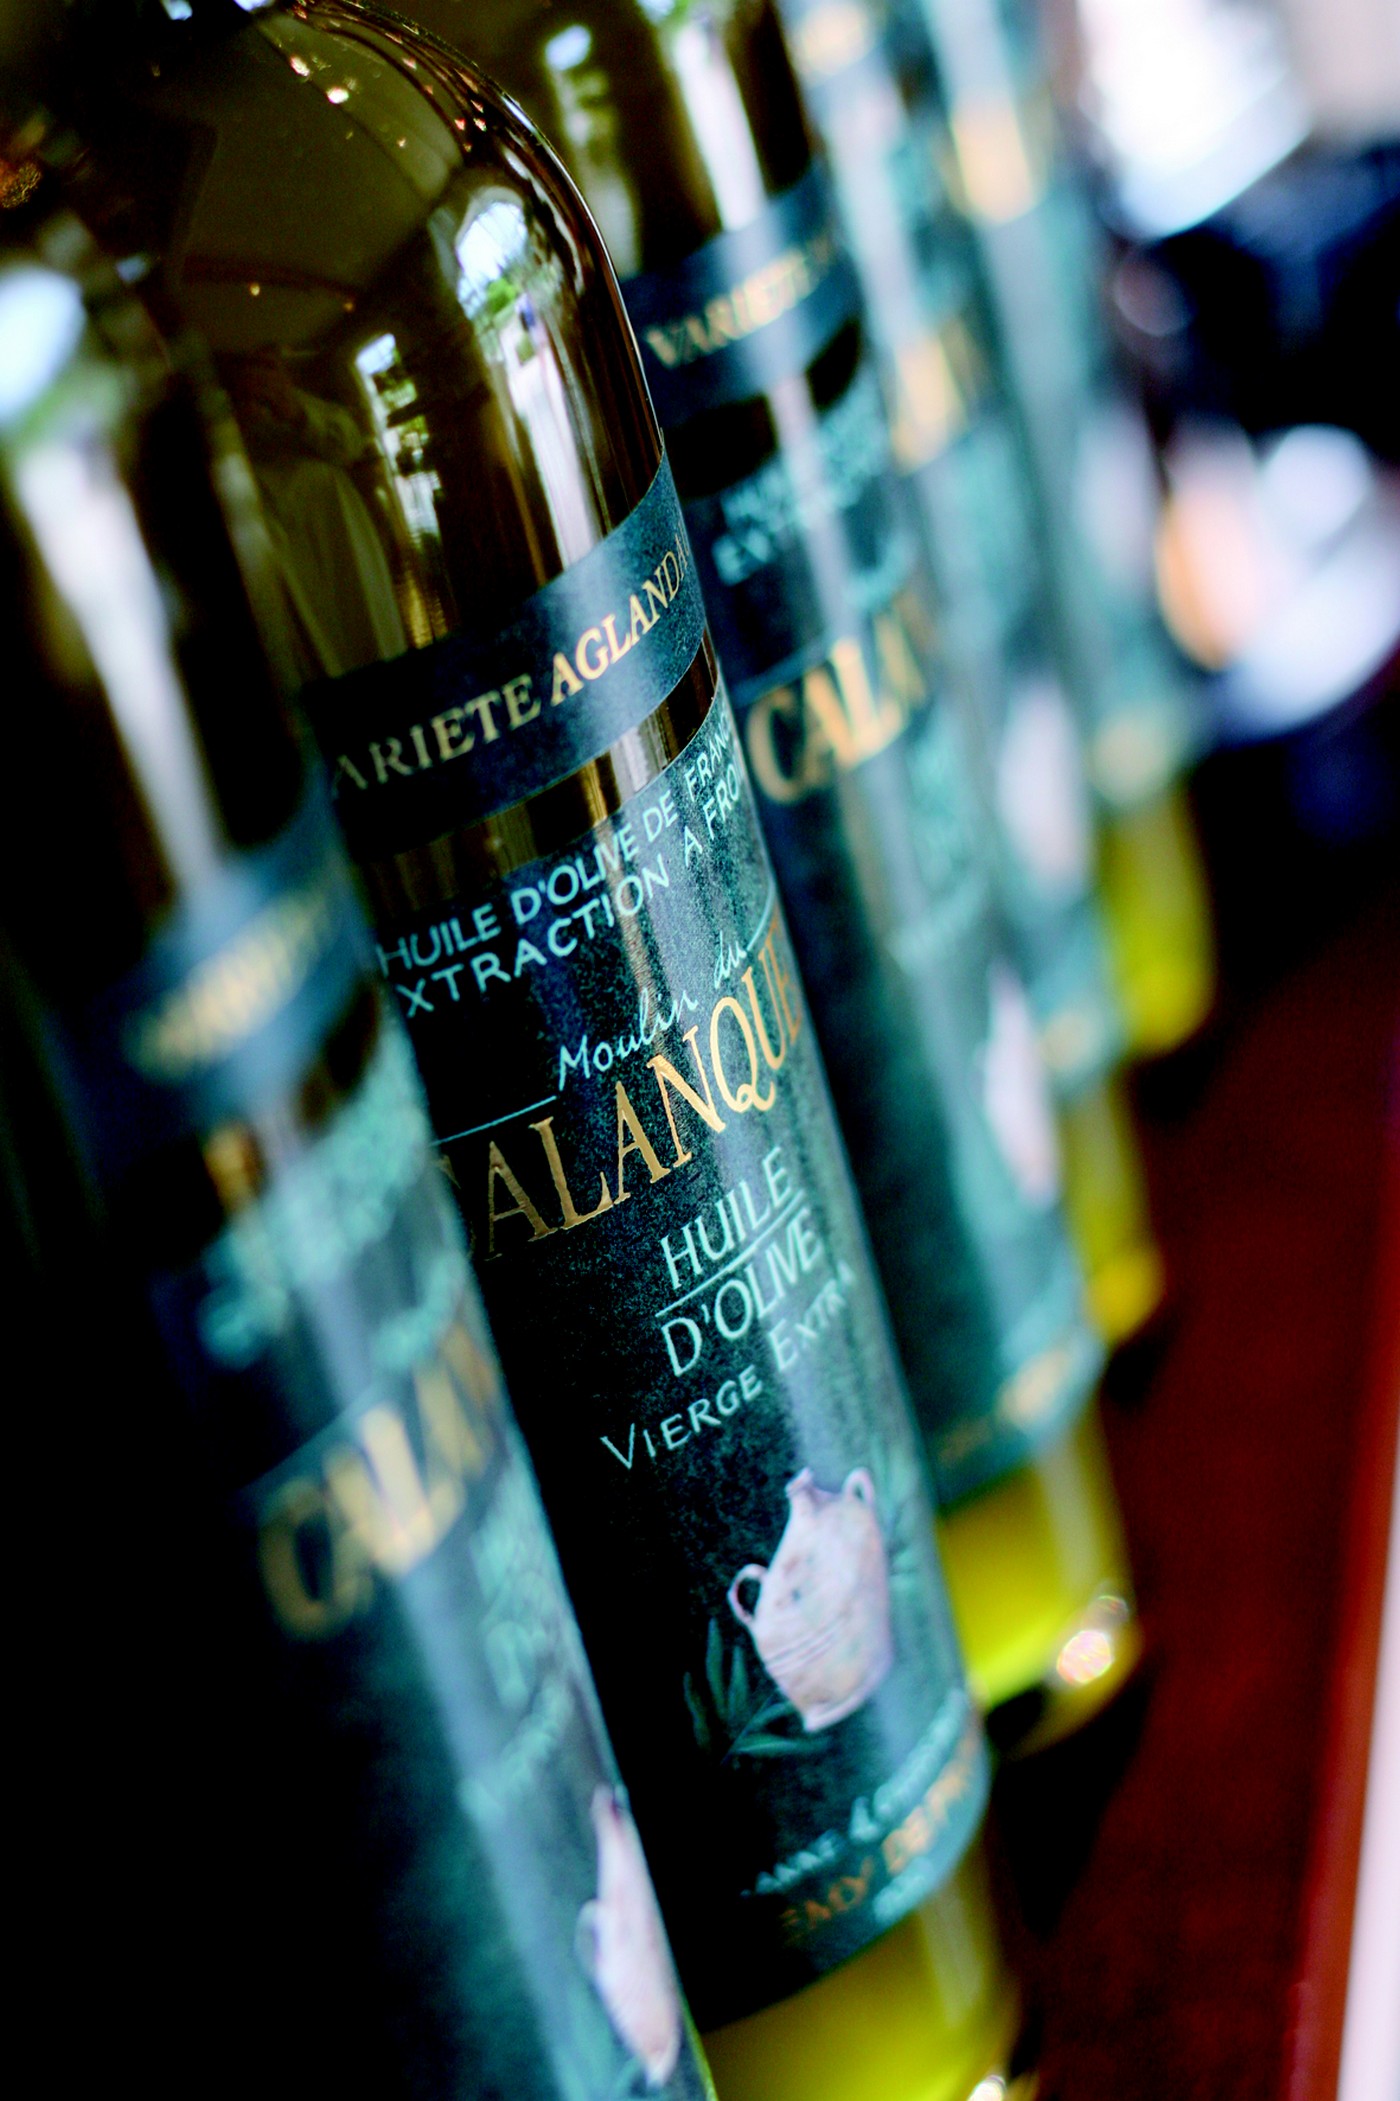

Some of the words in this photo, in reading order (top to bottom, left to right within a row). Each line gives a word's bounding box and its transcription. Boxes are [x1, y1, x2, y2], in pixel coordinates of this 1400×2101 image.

[330, 672, 542, 797] ARIETE
[376, 902, 501, 979] HUILE
[510, 822, 640, 925] D'OLIVE
[643, 790, 678, 843] DE
[395, 854, 669, 1018] XTRACTION
[683, 825, 703, 867] A
[702, 762, 740, 841] FRO
[559, 986, 698, 1092] Moulin
[713, 930, 747, 989] du
[658, 1146, 792, 1290] HUILE
[660, 1207, 824, 1378] D'OLIVE
[600, 1364, 764, 1470] VIERGE
